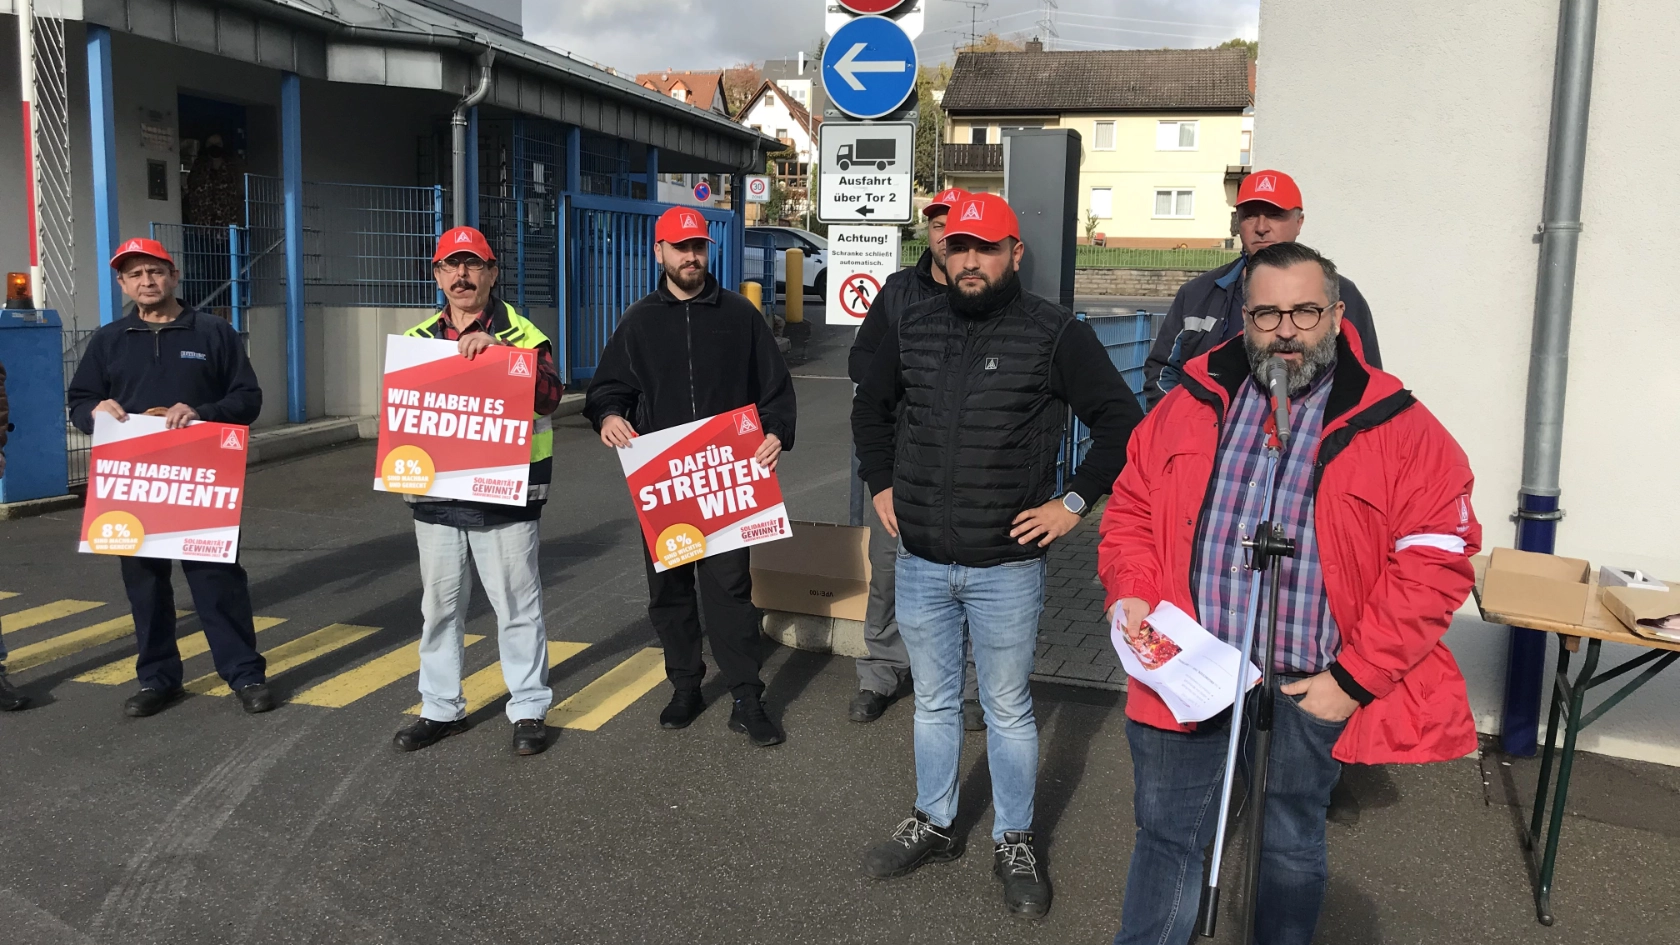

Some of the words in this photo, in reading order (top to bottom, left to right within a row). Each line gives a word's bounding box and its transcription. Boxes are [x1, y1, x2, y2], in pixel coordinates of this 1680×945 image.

[753, 182, 762, 190] 30
[838, 176, 892, 186] Ausfahrt
[834, 193, 862, 202] über
[865, 193, 885, 202] Tor
[888, 193, 896, 202] 2
[837, 234, 888, 244] Achtung!
[388, 388, 420, 406] WIR
[423, 392, 480, 413] HABEN
[483, 398, 504, 415] ES
[387, 406, 529, 445] VERDIENT!
[668, 444, 734, 477] DAFÜR
[96, 459, 131, 476] WIR
[134, 463, 192, 481] HABEN
[195, 468, 216, 483] ES
[473, 476, 515, 487] SOLIDARITÄT
[639, 456, 770, 511] STREITEN
[96, 476, 239, 510] VERDIENT!
[697, 484, 757, 520] WIR
[740, 520, 777, 532] SOLIDARITÄT
[184, 538, 224, 546] SOLIDARITÄT
[664, 552, 678, 561] SIND
[678, 542, 702, 555] WICHTIG
[668, 558, 680, 566] UND
[681, 548, 703, 561] RICHTIG
